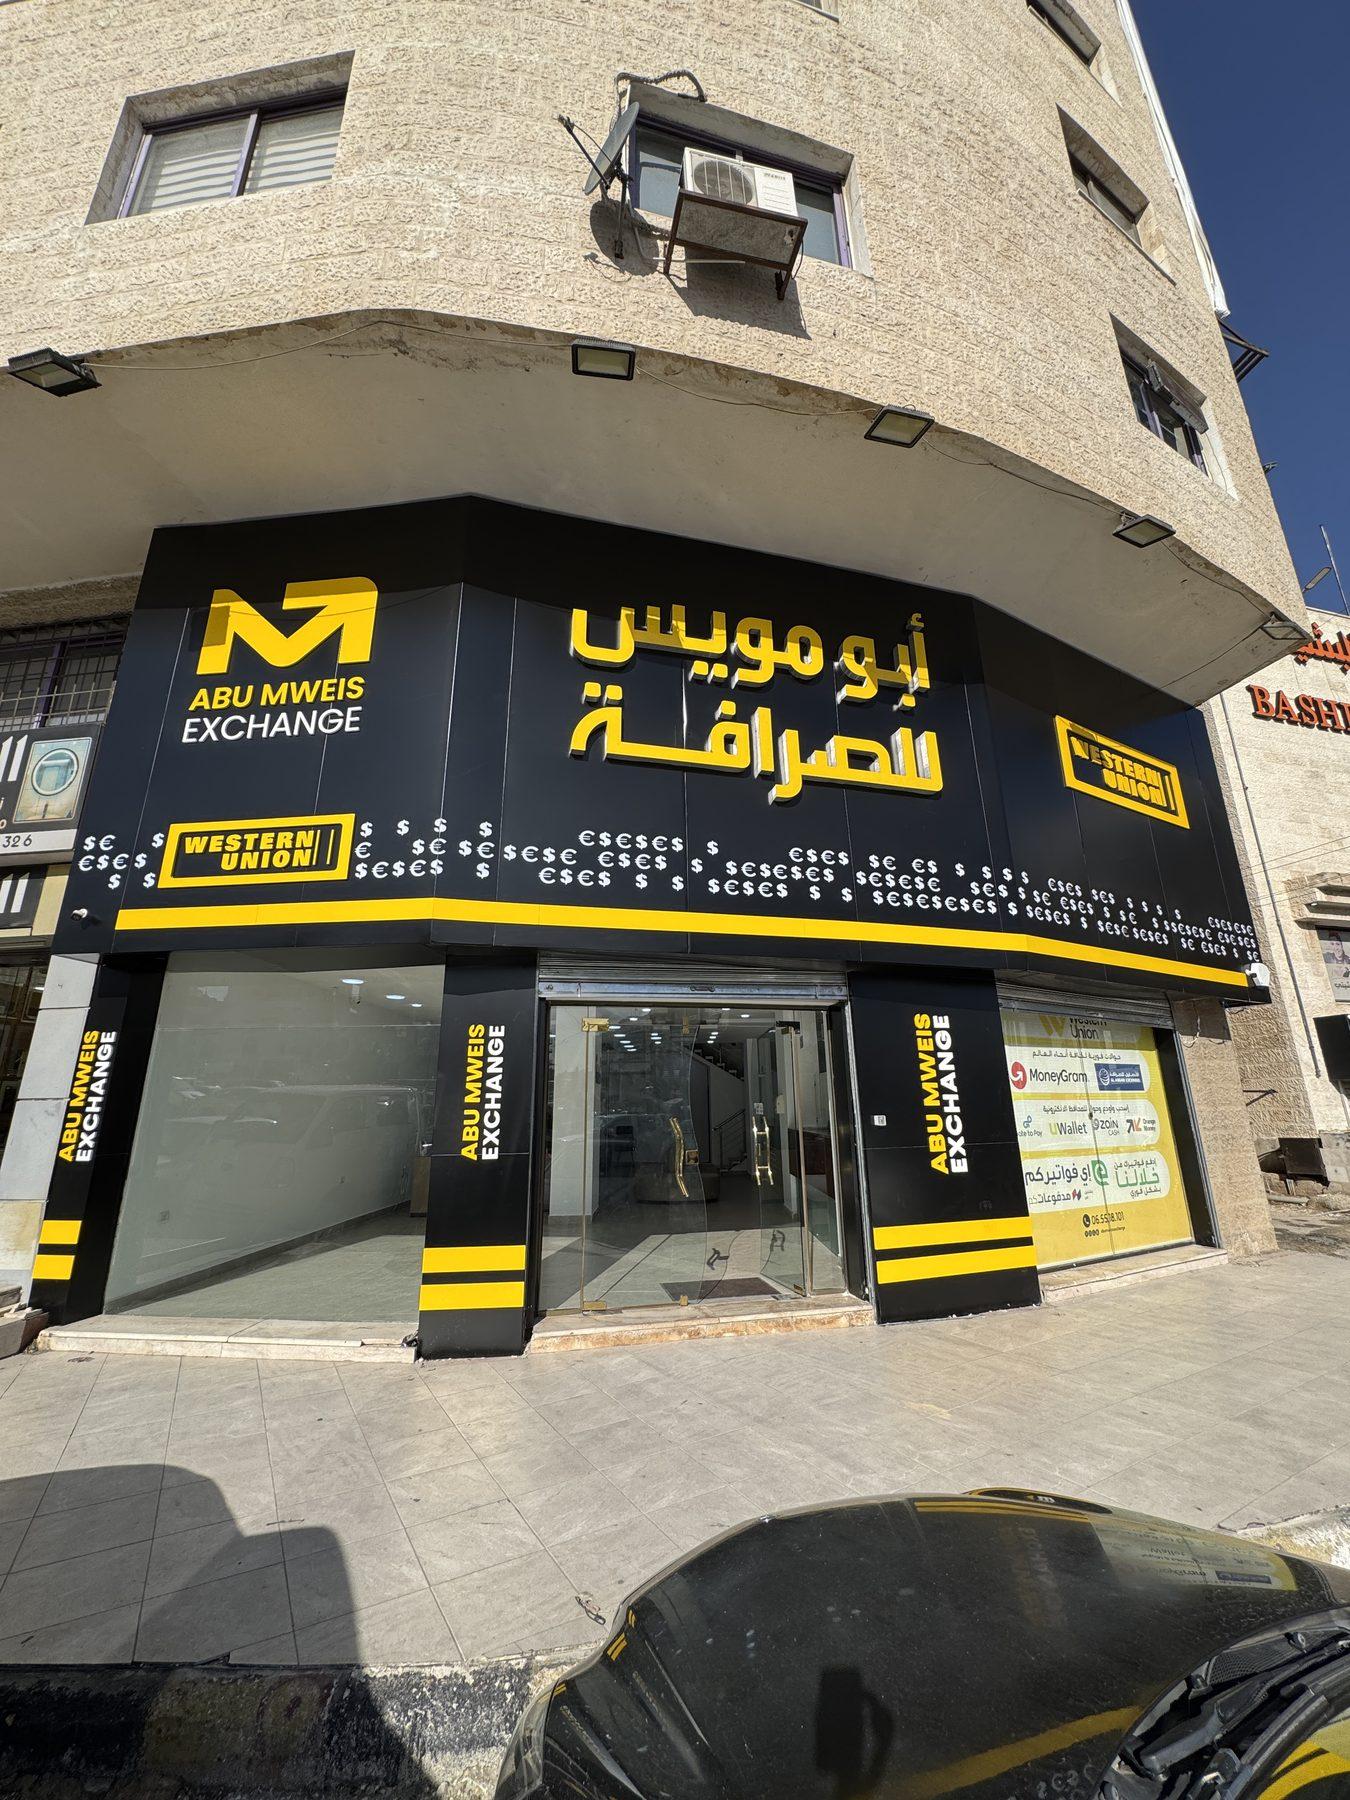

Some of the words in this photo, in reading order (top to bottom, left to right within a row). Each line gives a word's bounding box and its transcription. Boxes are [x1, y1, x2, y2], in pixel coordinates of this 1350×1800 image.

[569, 603, 825, 688] مويس
[836, 612, 931, 712] أبو
[188, 684, 255, 711] ABU
[260, 675, 367, 706] MWEIS
[181, 706, 363, 744] EXCHANGE
[568, 680, 944, 806] للصرافة
[1070, 736, 1161, 787] WESTERN
[1102, 768, 1165, 806] UNION
[184, 829, 314, 855] WESTERN
[220, 848, 312, 871] UNION
[1070, 1025, 1099, 1039] Union
[69, 1030, 100, 1107] MWEIS
[464, 1023, 485, 1103] MWEIS
[914, 1013, 941, 1107] MWEIS
[75, 1031, 117, 1162] EXCHANGE
[482, 1025, 506, 1160] EXCHANGE
[932, 1015, 969, 1173] EXCHANGE
[58, 1112, 82, 1162] ABU
[461, 1109, 481, 1161] ABU
[925, 1114, 949, 1175] ABU
[1024, 1162, 1079, 1186] فواتيركم
[1080, 1164, 1091, 1186] إي
